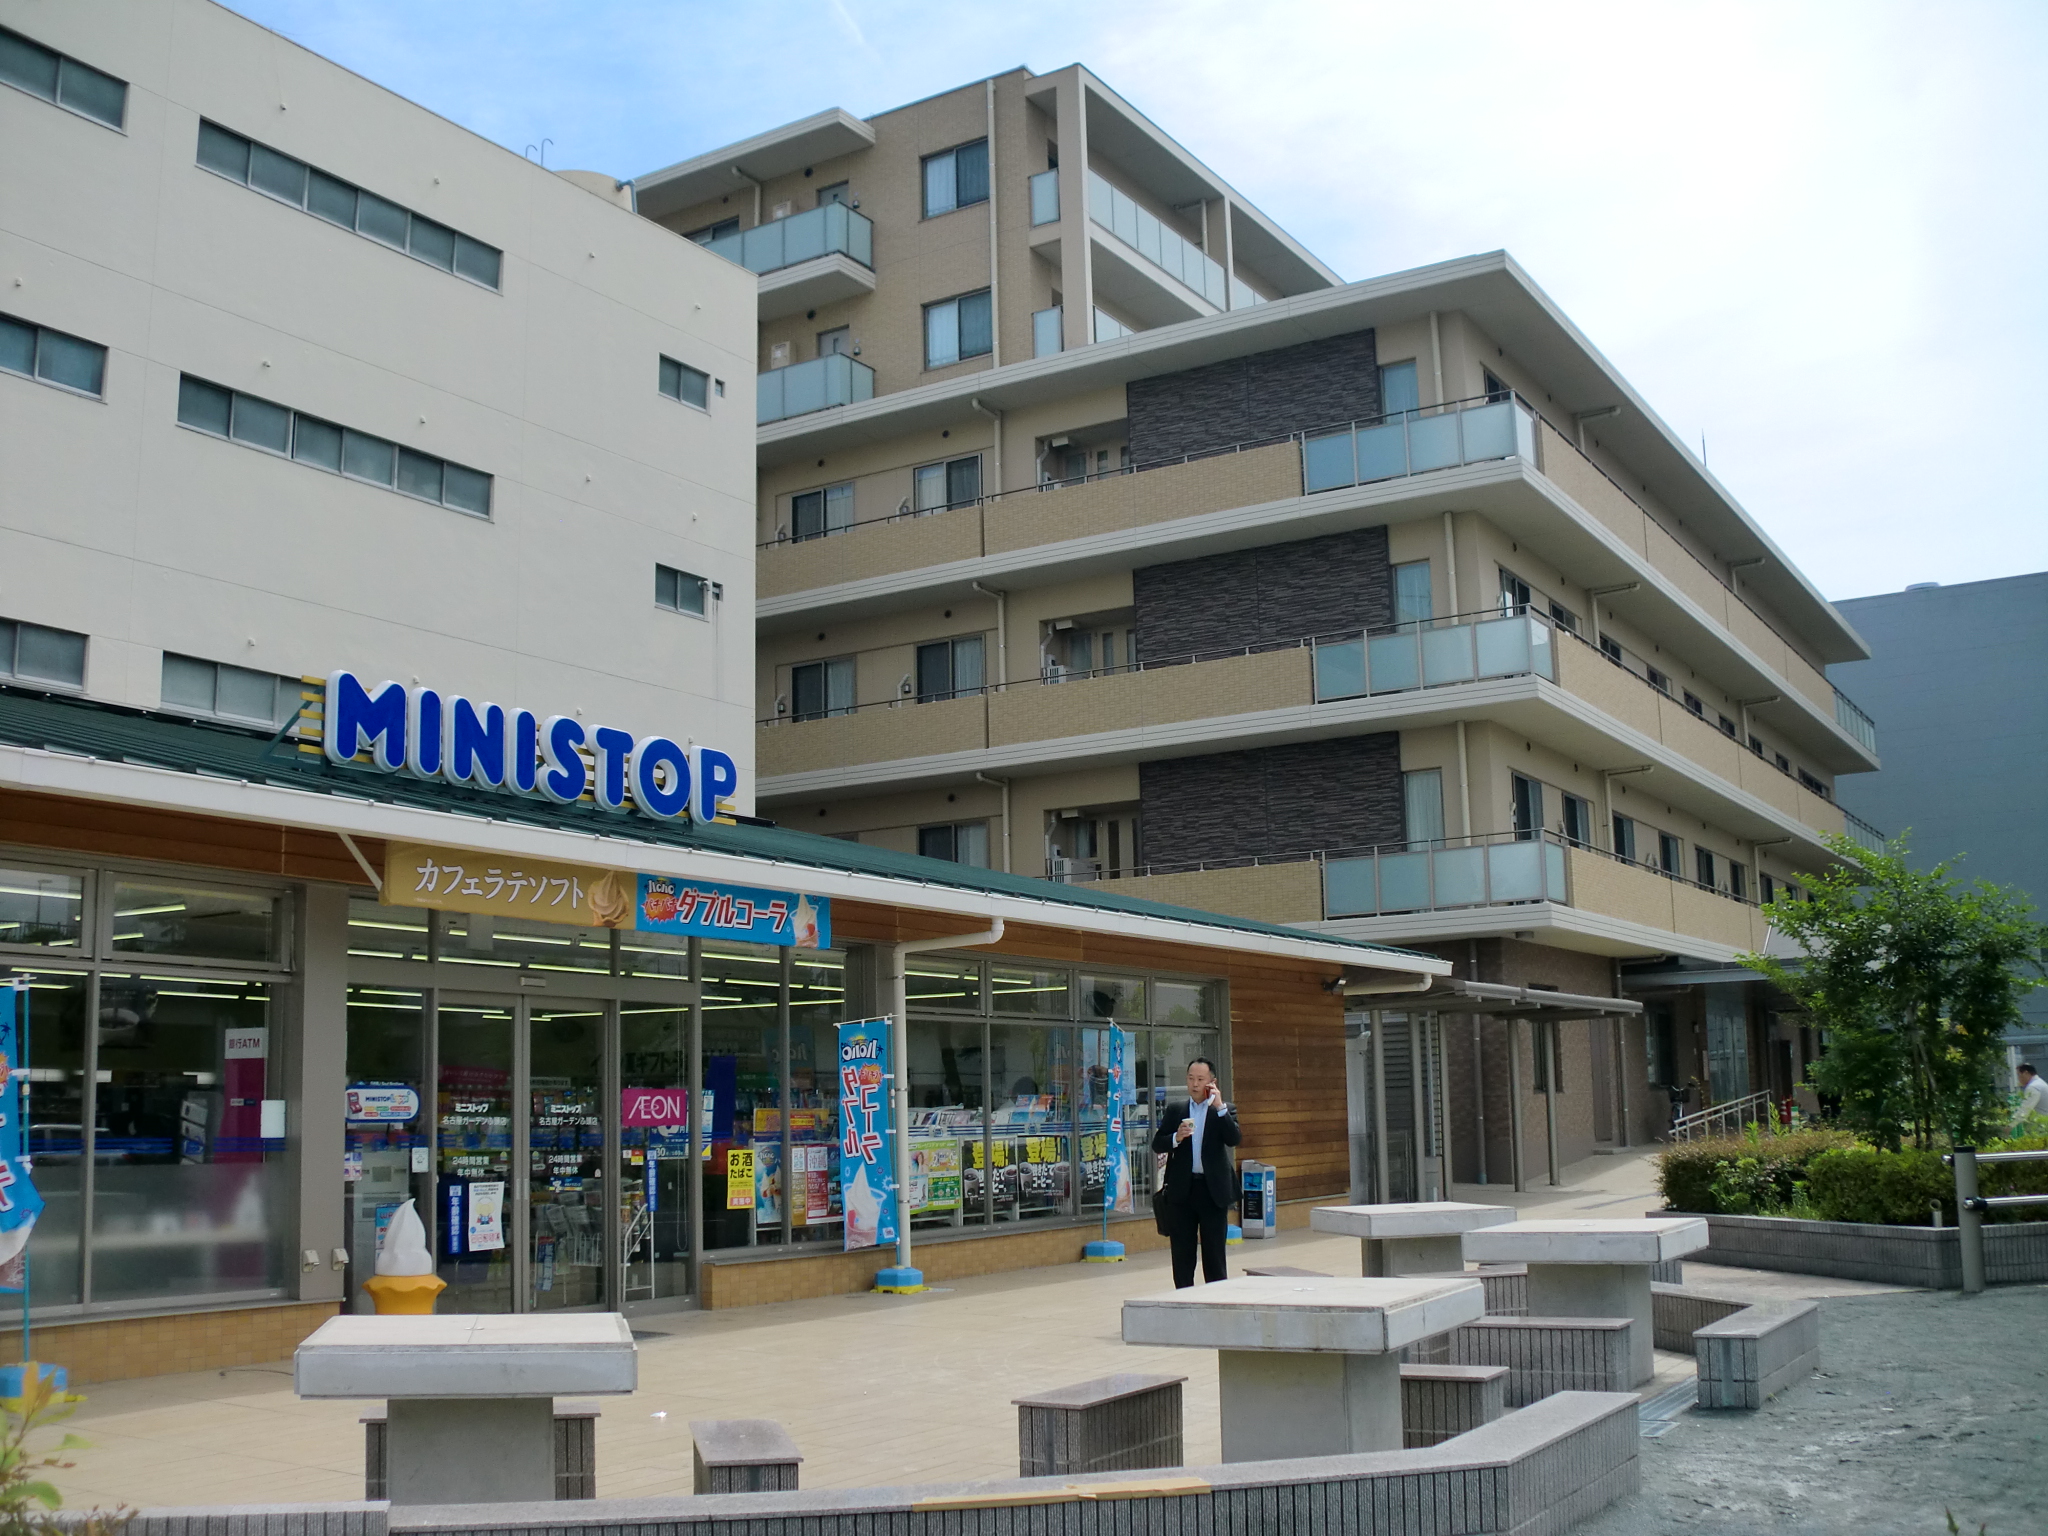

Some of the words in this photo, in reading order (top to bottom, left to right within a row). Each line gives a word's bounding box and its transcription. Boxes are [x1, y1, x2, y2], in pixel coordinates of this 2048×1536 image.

[325, 669, 738, 825] MINISTOP
[414, 858, 584, 909] カフェラテソフト
[676, 887, 788, 934] ダブルコーラ
[454, 1103, 489, 1113] ミニストップ
[550, 1104, 582, 1114] ミニストップ
[730, 1152, 753, 1167] お酒
[730, 1168, 753, 1179] たばこ
